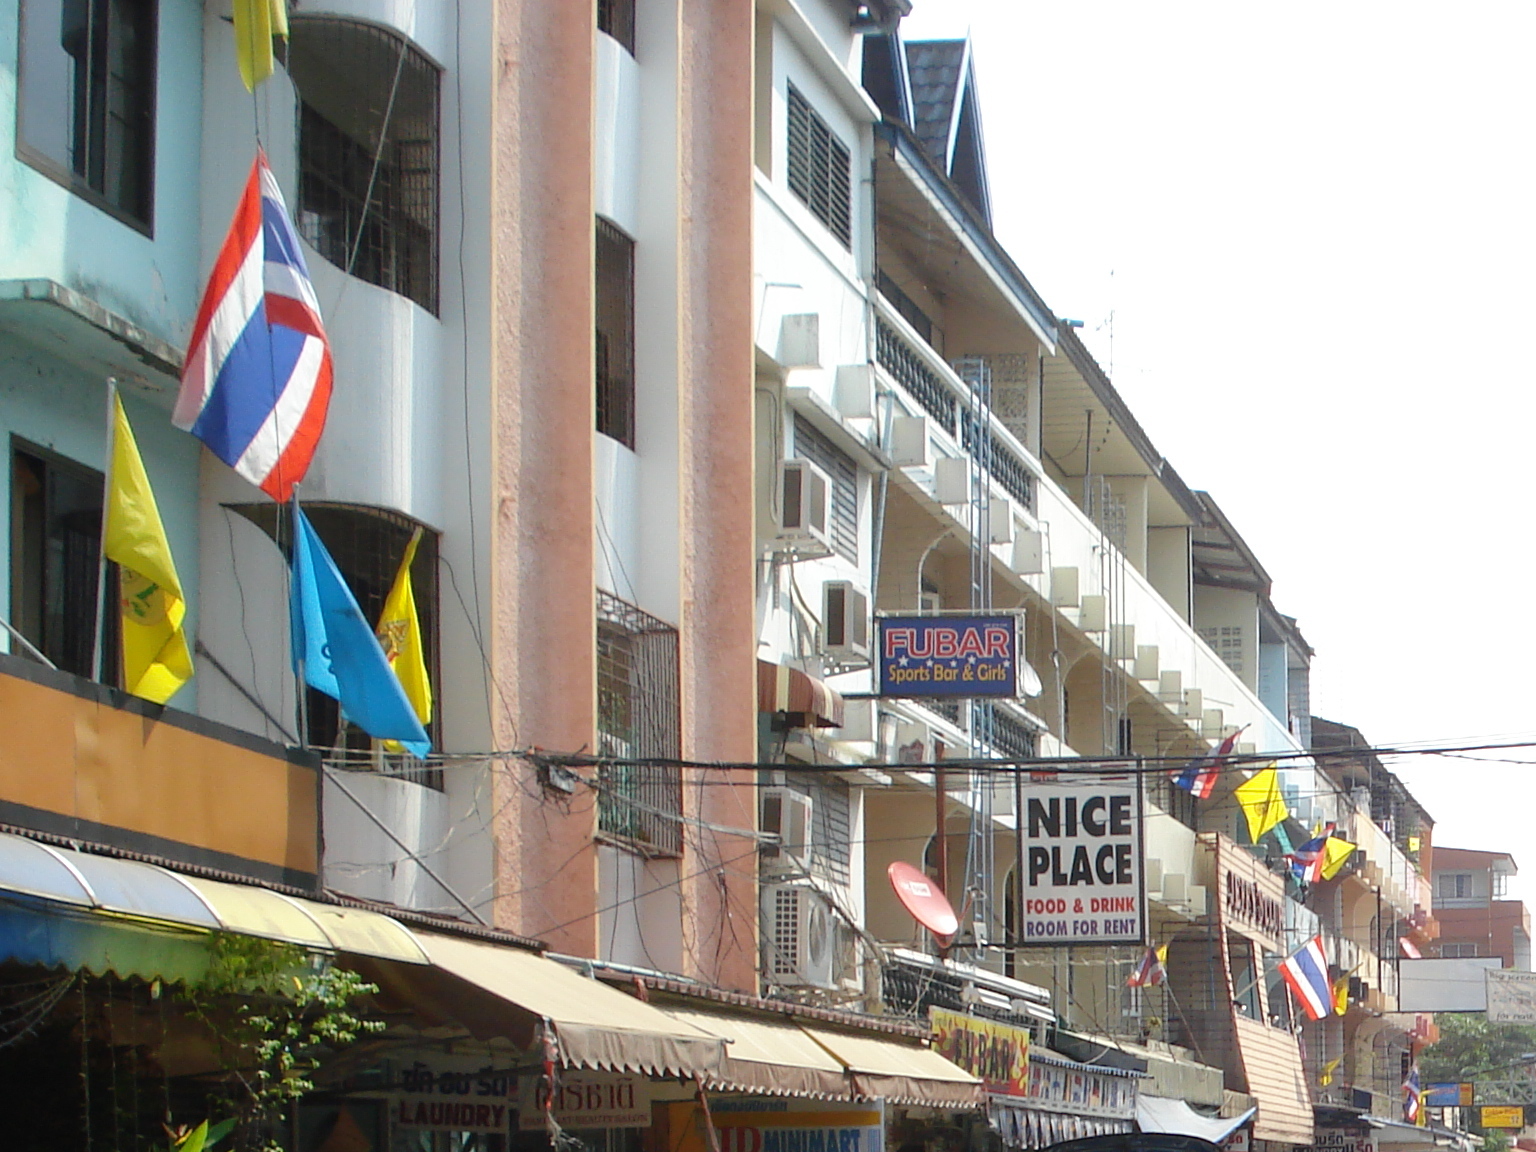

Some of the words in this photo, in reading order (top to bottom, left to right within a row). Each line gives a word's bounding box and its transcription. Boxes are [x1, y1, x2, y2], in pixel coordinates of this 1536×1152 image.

[885, 628, 1010, 659] FUBAR
[889, 664, 930, 682] Sports
[933, 664, 959, 680] Bar
[962, 663, 974, 680] &
[977, 663, 1007, 681] Girls
[1028, 796, 1132, 838] NICE
[1028, 844, 1133, 887] PLACE
[1027, 898, 1066, 914] FOOD
[1073, 897, 1084, 913] &
[1090, 896, 1135, 913] DRINK
[1027, 920, 1067, 937] ROOM
[1073, 920, 1098, 936] FOR
[1104, 919, 1136, 935] RENT
[400, 1100, 505, 1127] LAUNDRY
